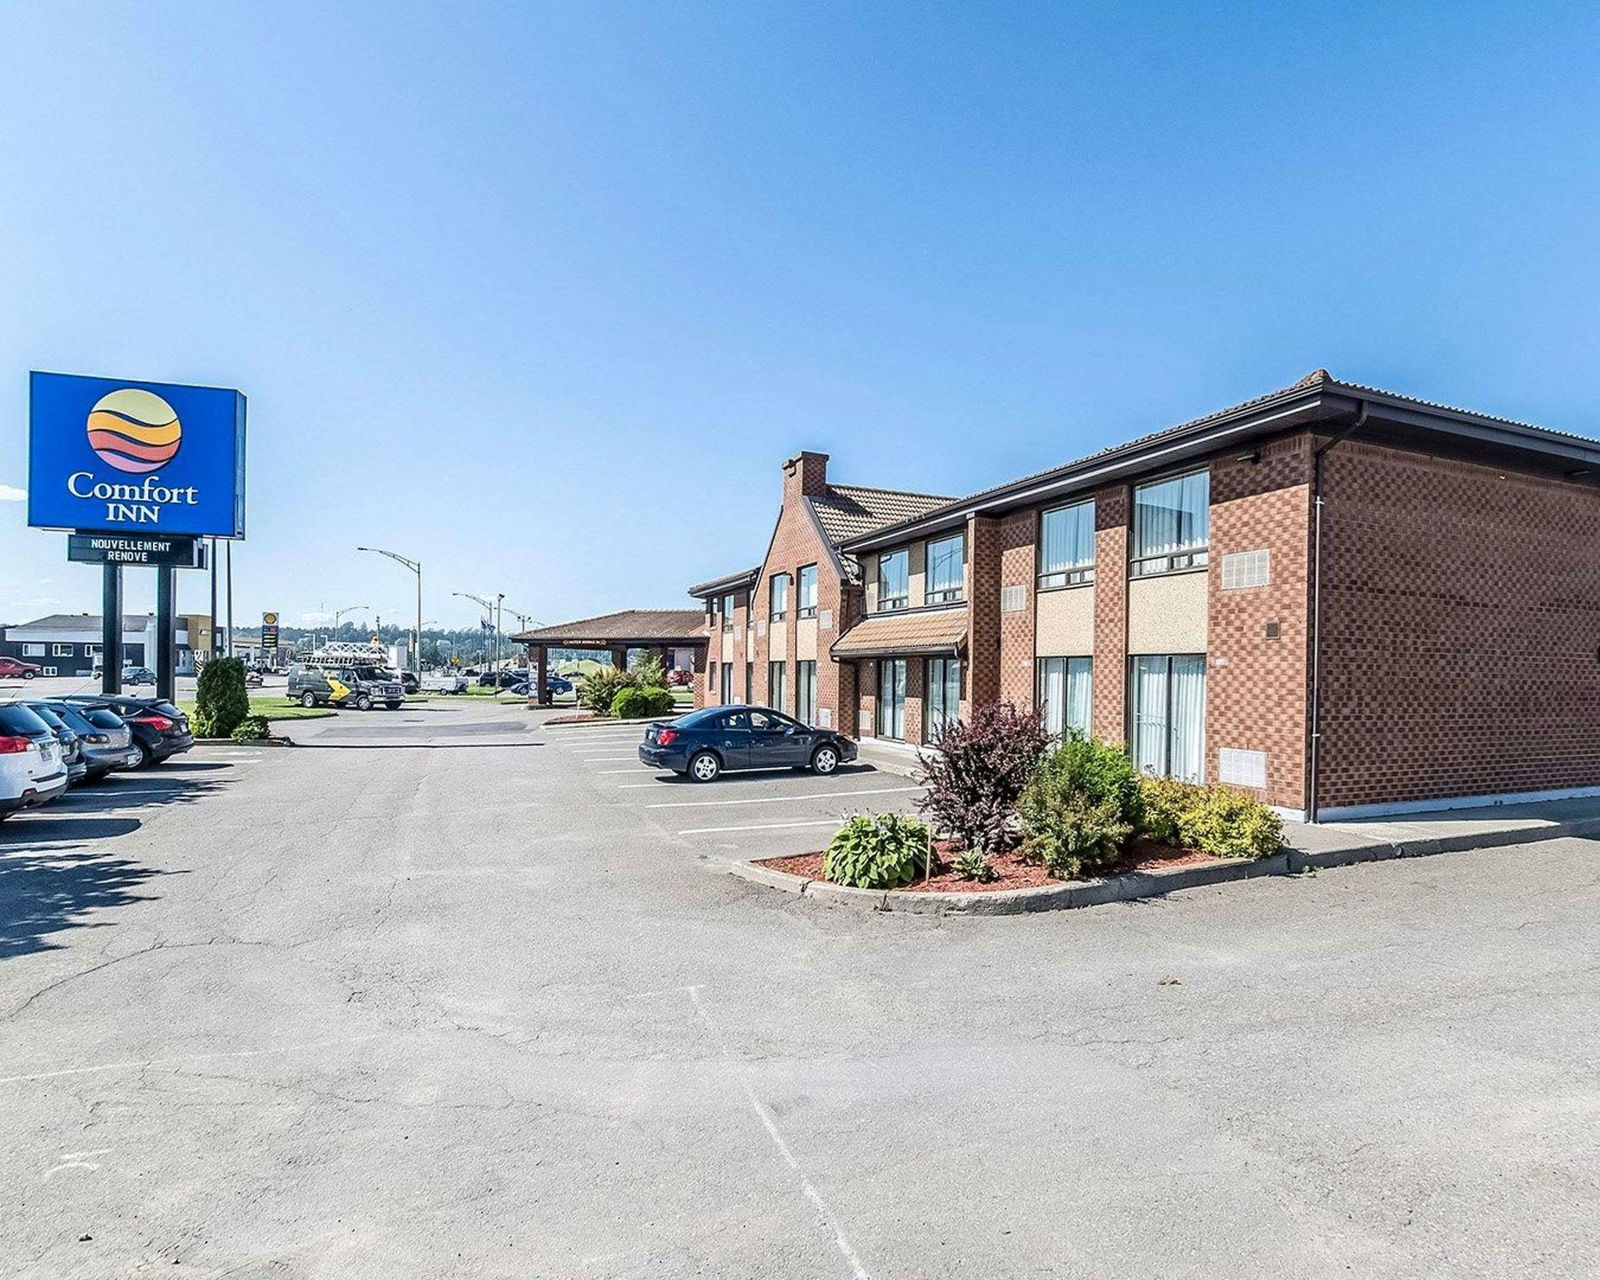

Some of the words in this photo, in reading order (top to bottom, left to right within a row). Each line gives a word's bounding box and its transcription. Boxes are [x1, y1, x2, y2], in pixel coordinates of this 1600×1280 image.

[67, 471, 199, 505] Comfort
[105, 503, 160, 523] INN
[91, 539, 171, 552] NOUVELLEMENT
[107, 551, 148, 562] RENOVE
